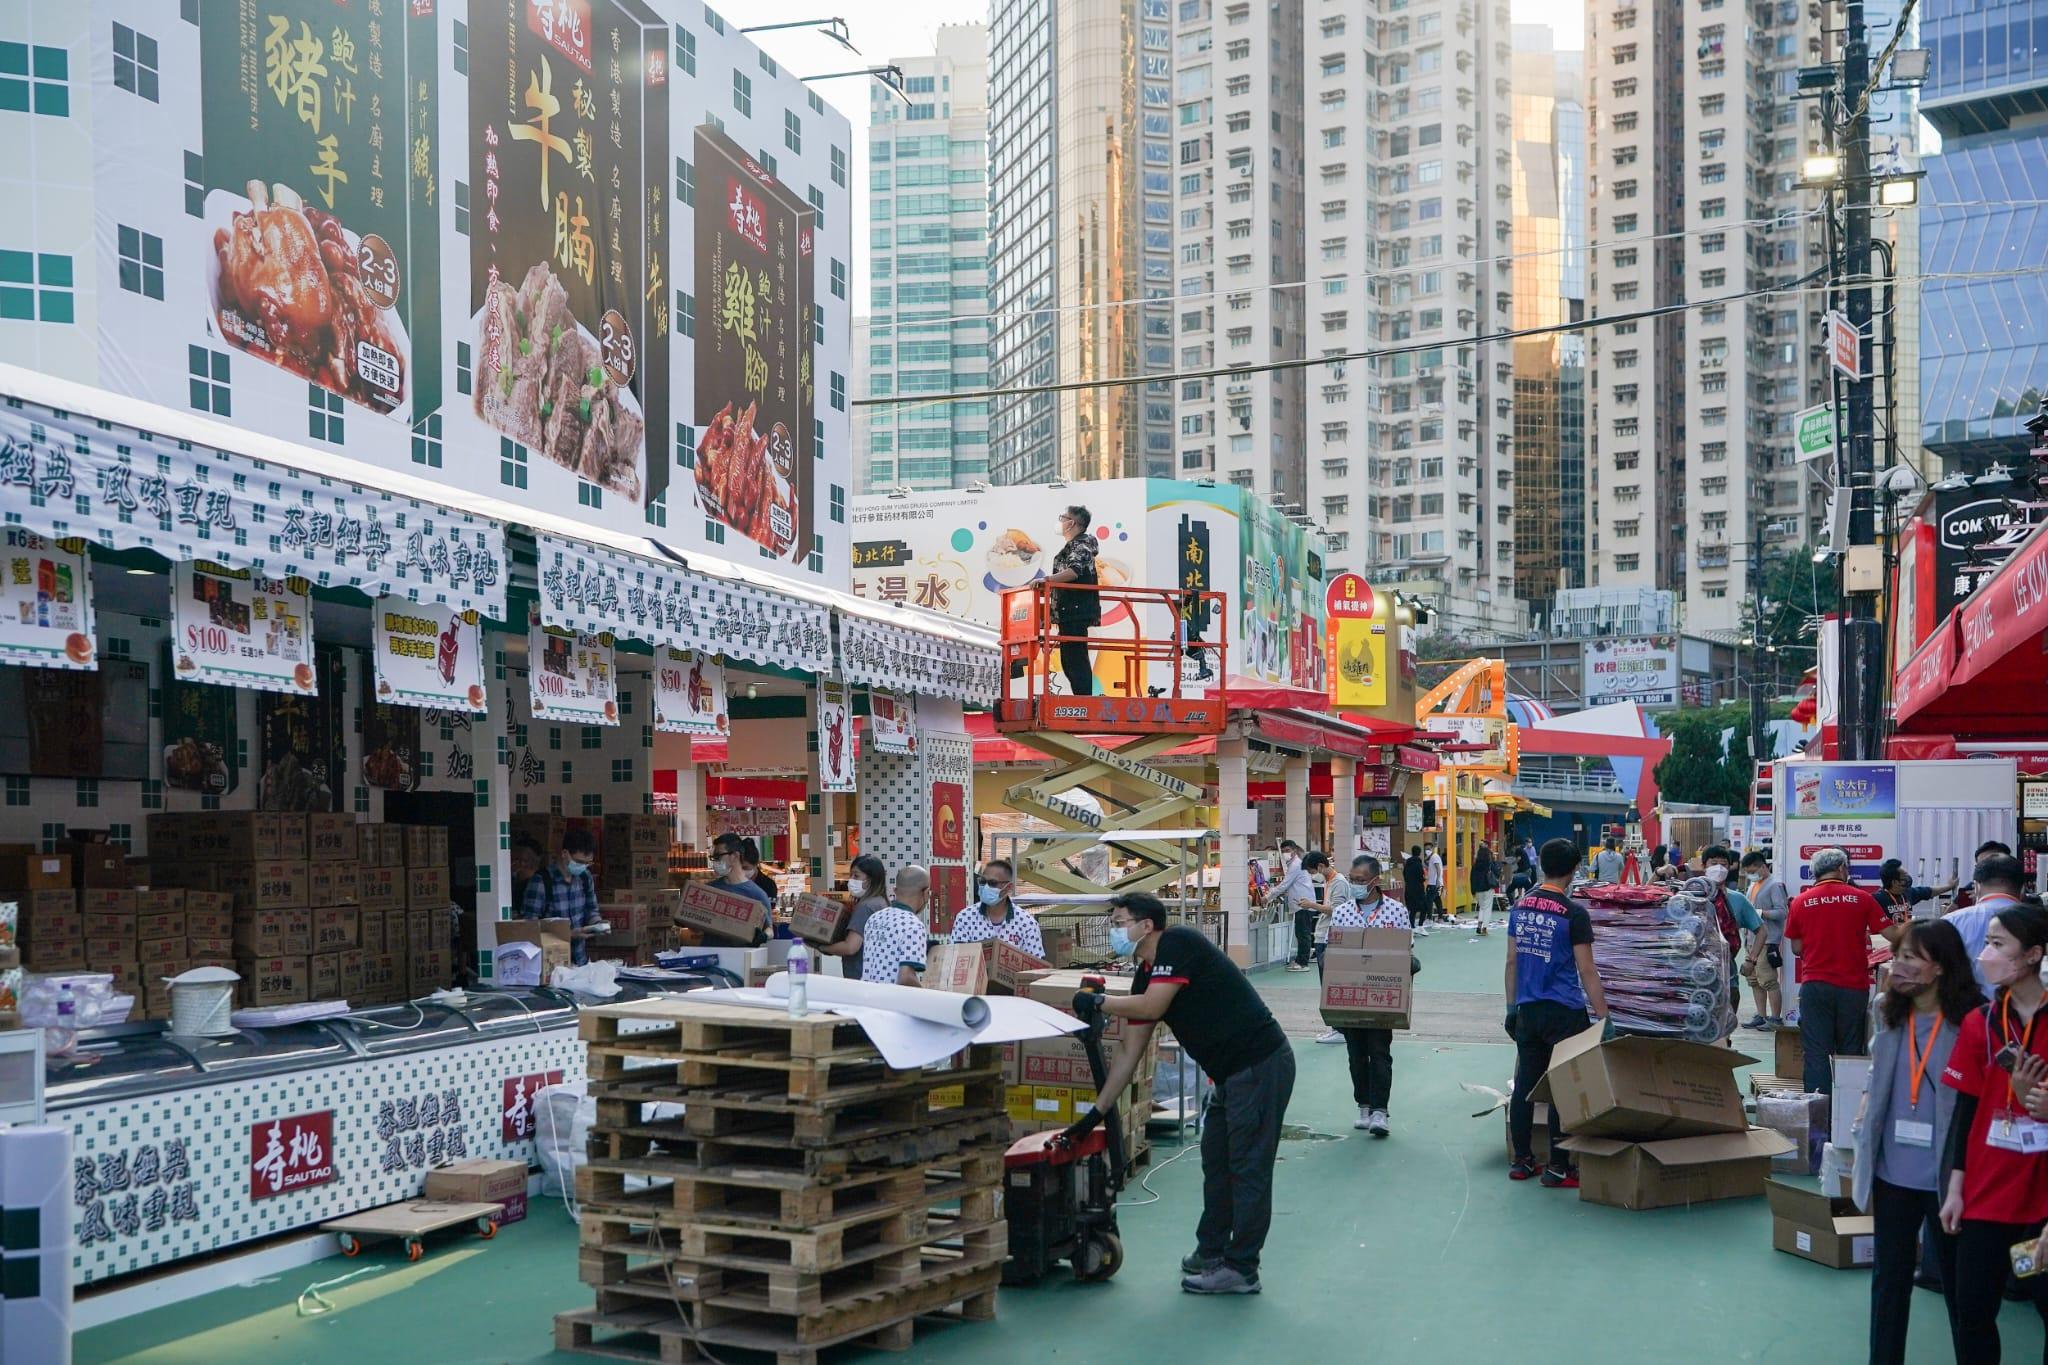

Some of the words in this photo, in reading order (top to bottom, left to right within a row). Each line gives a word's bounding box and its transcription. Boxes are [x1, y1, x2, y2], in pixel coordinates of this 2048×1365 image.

[507, 22, 516, 56] BEEF
[554, 33, 592, 70] SAUTAO
[330, 25, 358, 125] 鮑汁
[507, 59, 517, 117] BRISKET
[264, 14, 348, 209] 豬手
[508, 54, 595, 286] 牛腩
[743, 230, 767, 252] SAUTAO
[757, 269, 773, 344] 鮑汁
[721, 259, 769, 405] 雞腳
[362, 345, 395, 371] 加熱即食
[103, 463, 237, 530] 風味重現
[929, 500, 956, 508] COMPANY
[281, 504, 387, 563] 茶記經典
[405, 529, 496, 585] 風味重現
[547, 566, 619, 611] 茶記經典
[630, 584, 694, 626] 風味重現
[187, 624, 228, 654] $100
[539, 674, 563, 697] $100
[660, 667, 681, 693] $50
[1055, 706, 1087, 718] 1932R
[1184, 711, 1208, 721] JLG
[1124, 759, 1151, 779] 2771
[1154, 773, 1185, 792] 3118
[1047, 796, 1102, 829] P1860
[1537, 897, 1568, 914] INSTINCT
[1804, 897, 1819, 907] LEE
[1821, 896, 1840, 904] KUM
[1842, 894, 1858, 903] KEE
[377, 1089, 461, 1140] 茶記經典
[383, 1124, 466, 1173] 風味重現
[74, 1138, 187, 1204] 茶記經典
[284, 1166, 332, 1187] SAUTAO
[80, 1182, 199, 1245] 風味重現
